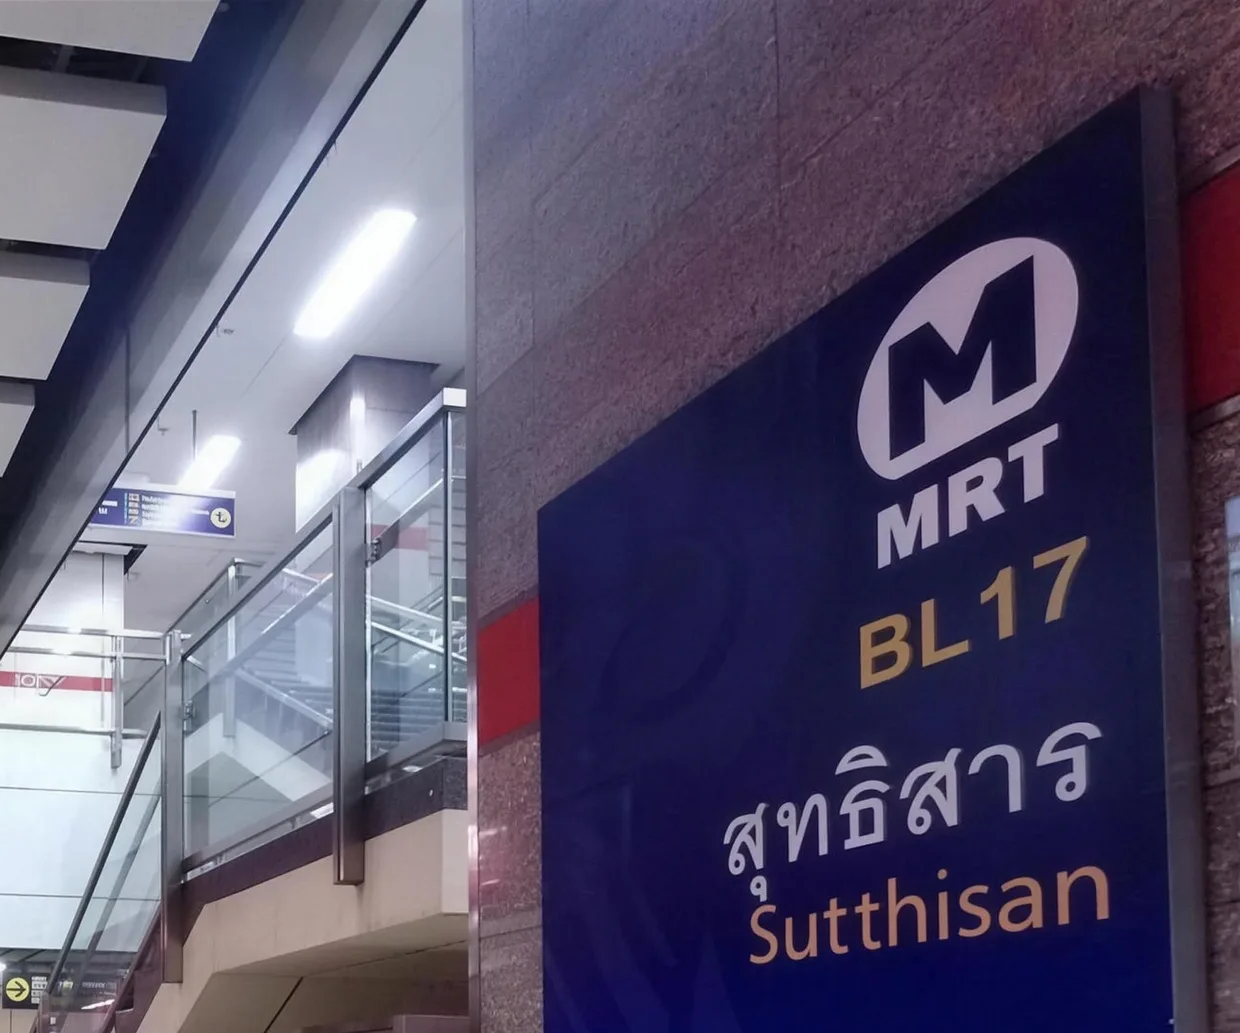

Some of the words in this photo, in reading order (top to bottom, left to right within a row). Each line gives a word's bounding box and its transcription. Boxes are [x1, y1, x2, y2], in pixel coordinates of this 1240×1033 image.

[877, 423, 1061, 570] MRT
[859, 537, 1088, 690] BL17
[723, 722, 1104, 901] สุทธิสาร
[749, 867, 1109, 965] Sutthisan
